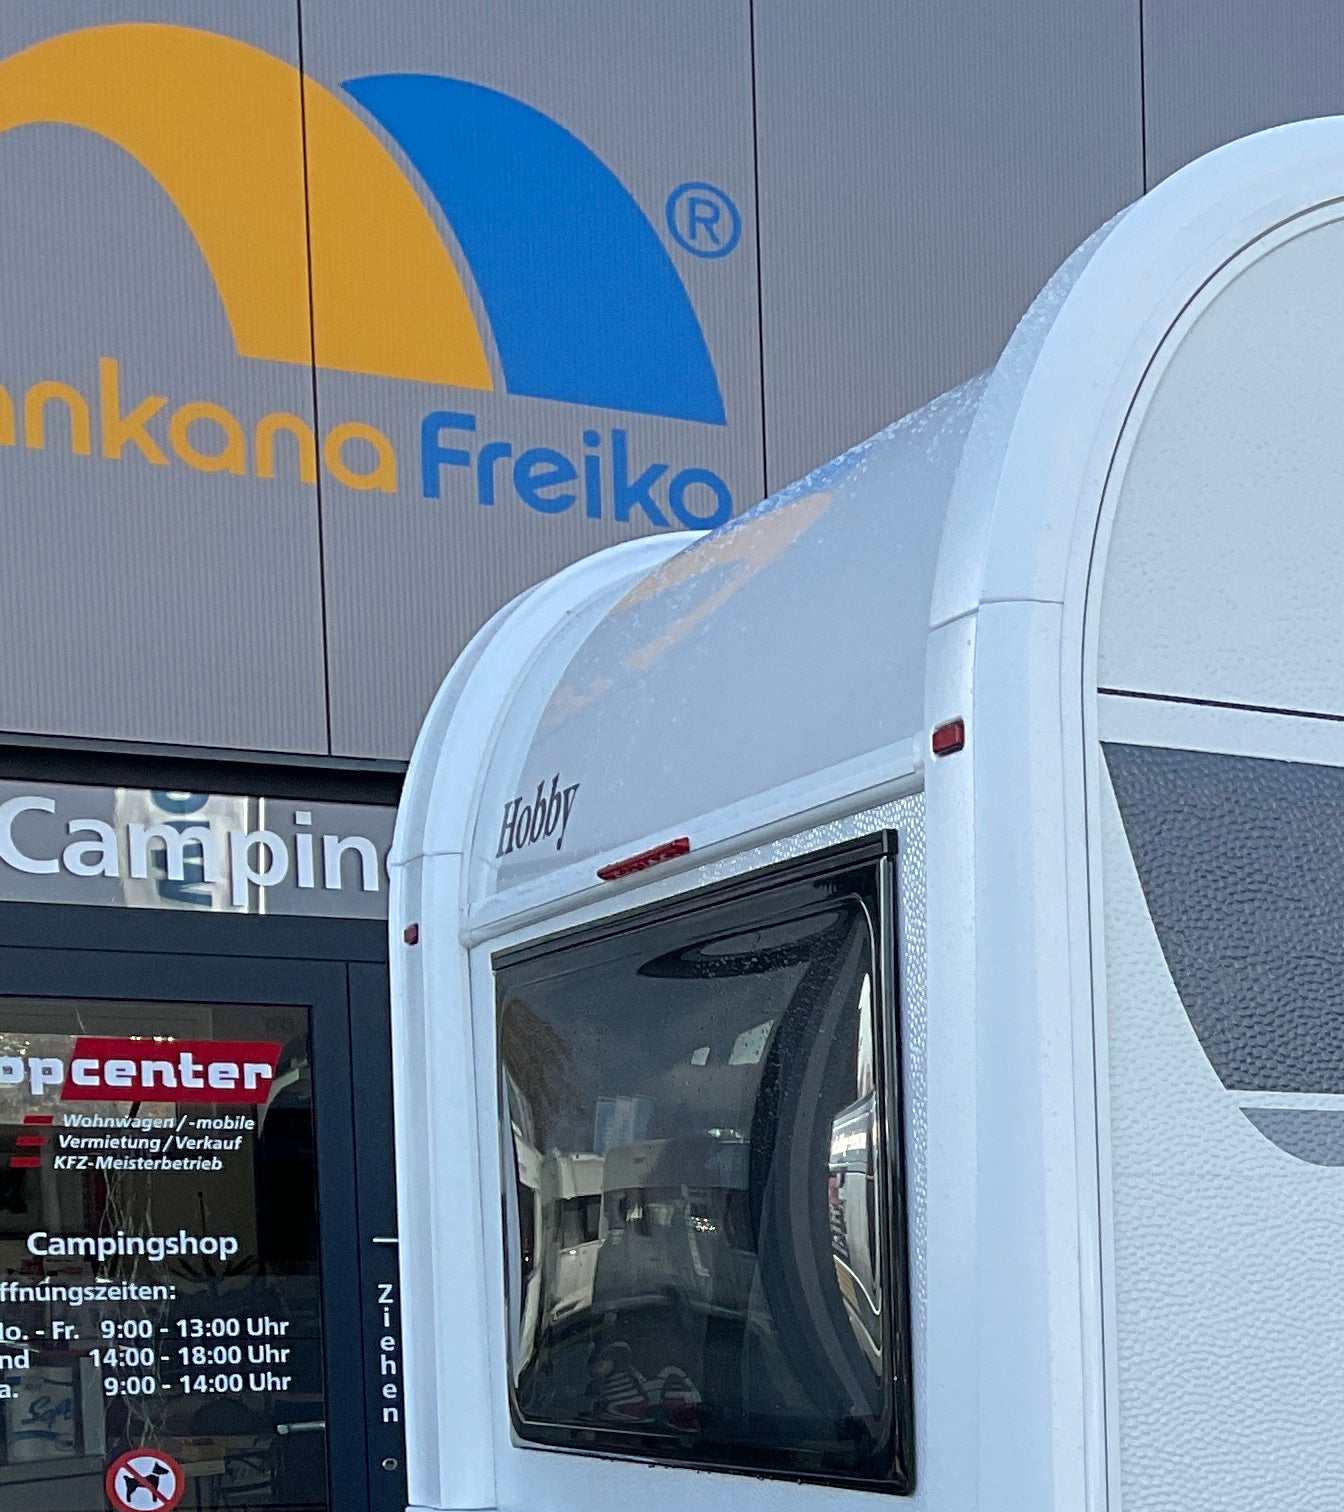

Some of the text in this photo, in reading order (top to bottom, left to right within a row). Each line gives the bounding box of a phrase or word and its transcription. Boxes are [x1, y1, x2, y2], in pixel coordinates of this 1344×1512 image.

[0, 355, 733, 530] nkana Freiko
[495, 772, 580, 859] Hobby
[53, 1154, 224, 1171] KFZ-Meisterbetrieb
[26, 1230, 239, 1262] Campingshop
[51, 1320, 81, 1340] Fr.
[100, 1319, 153, 1339] 9:00
[176, 1317, 241, 1338] 13:00
[246, 1316, 290, 1337] Uhr
[88, 1347, 155, 1368] 14:00
[177, 1345, 243, 1366] 18:00
[247, 1344, 291, 1364] Uhr
[377, 1283, 399, 1424] Ziehen
[103, 1375, 156, 1397] 9:00
[179, 1373, 243, 1394] 14:00
[248, 1371, 292, 1392] Uhr
